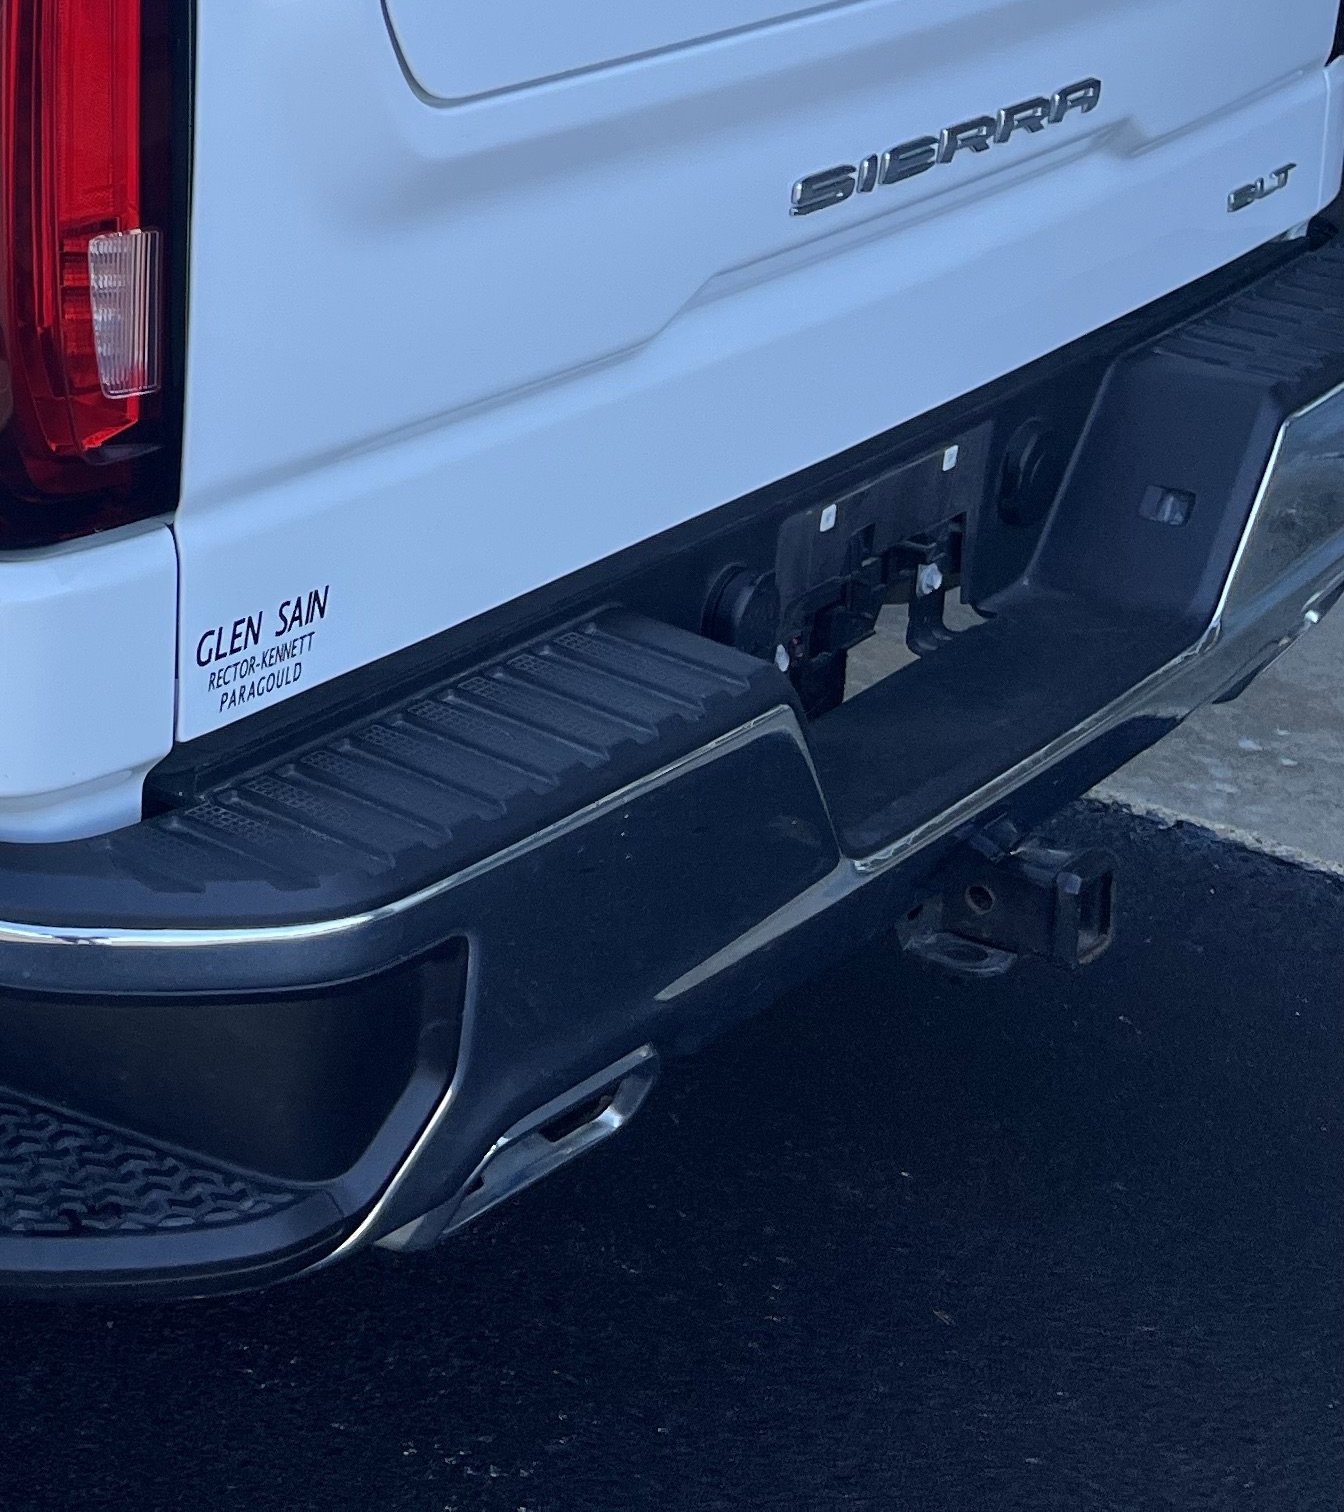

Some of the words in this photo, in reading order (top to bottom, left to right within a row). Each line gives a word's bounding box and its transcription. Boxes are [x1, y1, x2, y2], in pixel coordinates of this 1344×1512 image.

[789, 78, 1101, 216] SIERRA
[196, 610, 263, 667] GLEN
[275, 585, 330, 637] SAIN
[208, 631, 315, 692] RECTOR-KENNETT
[219, 662, 302, 713] PARAGOULD
